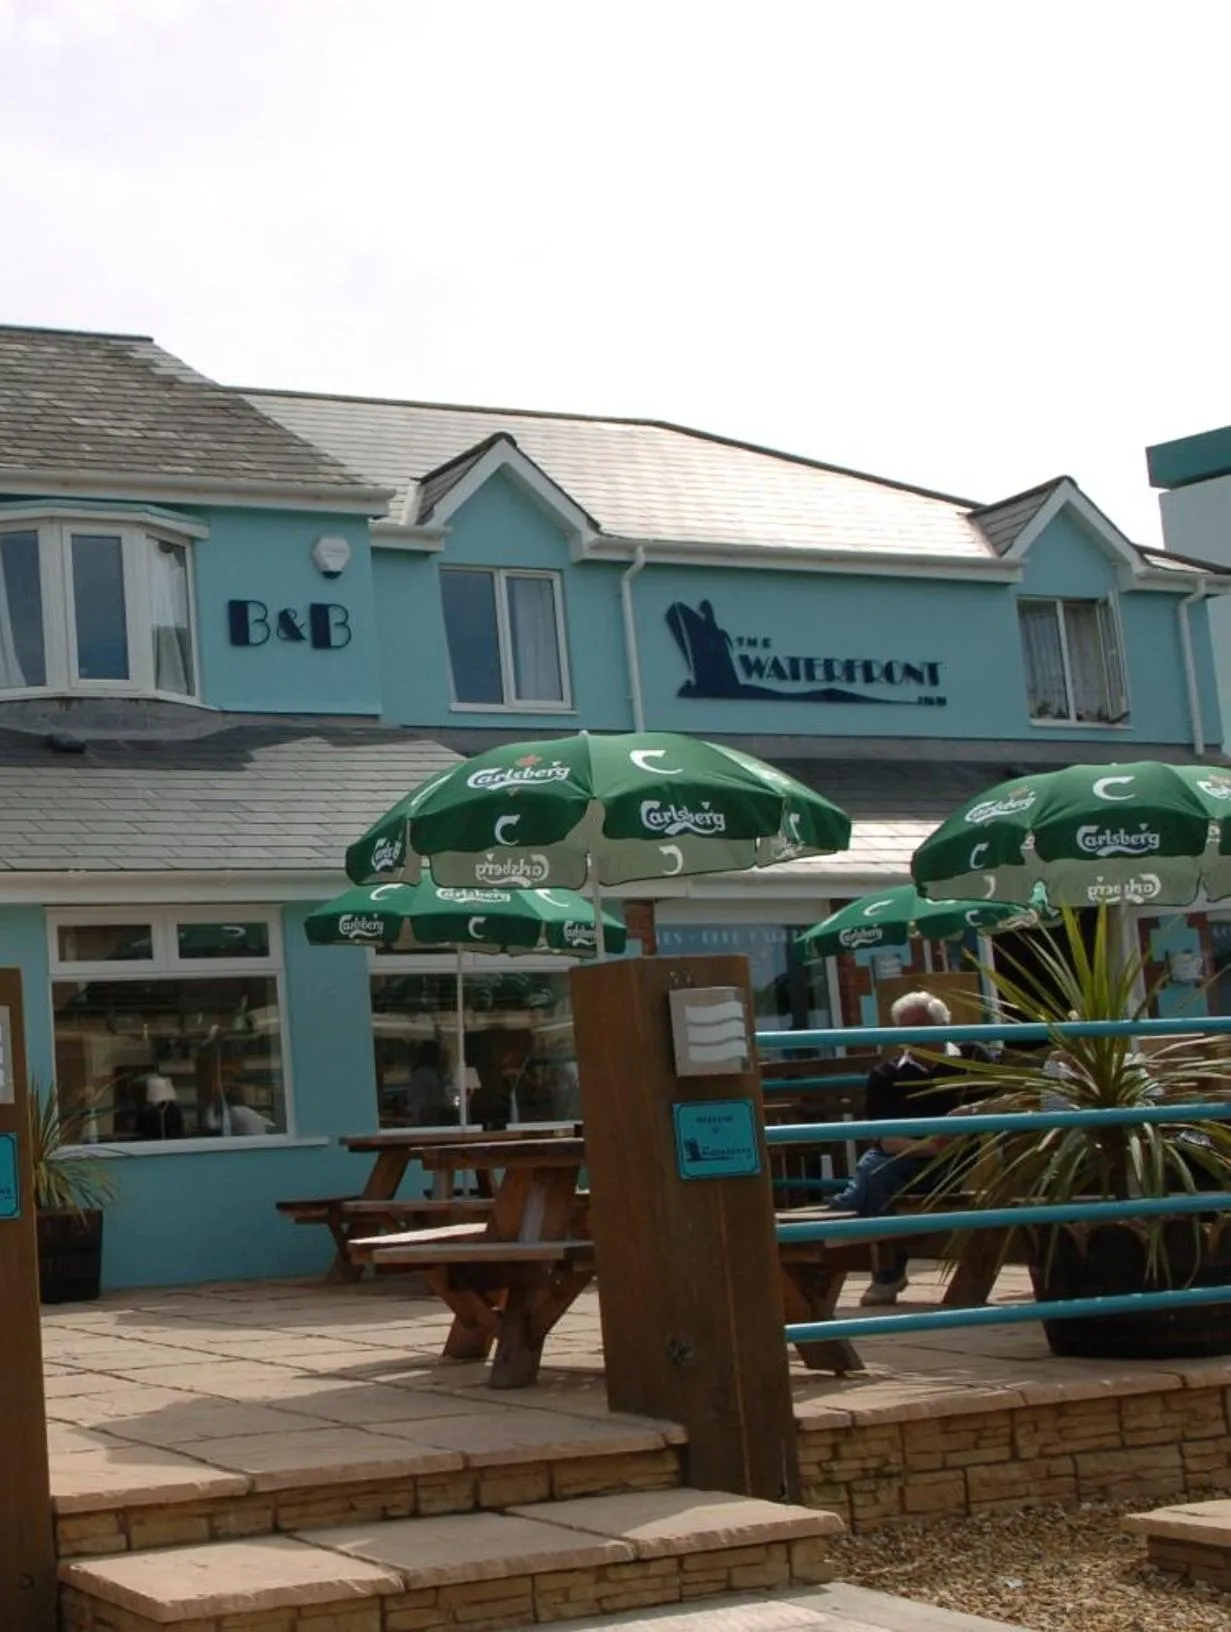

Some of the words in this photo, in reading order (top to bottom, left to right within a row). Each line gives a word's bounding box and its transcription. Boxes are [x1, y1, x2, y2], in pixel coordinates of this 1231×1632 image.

[227, 599, 352, 650] B&B
[735, 636, 773, 649] THE
[737, 653, 942, 687] WATERFRONT
[468, 761, 571, 790] Carlsberg
[640, 800, 726, 835] Carlsberg
[1076, 823, 1161, 856] Carlsberg
